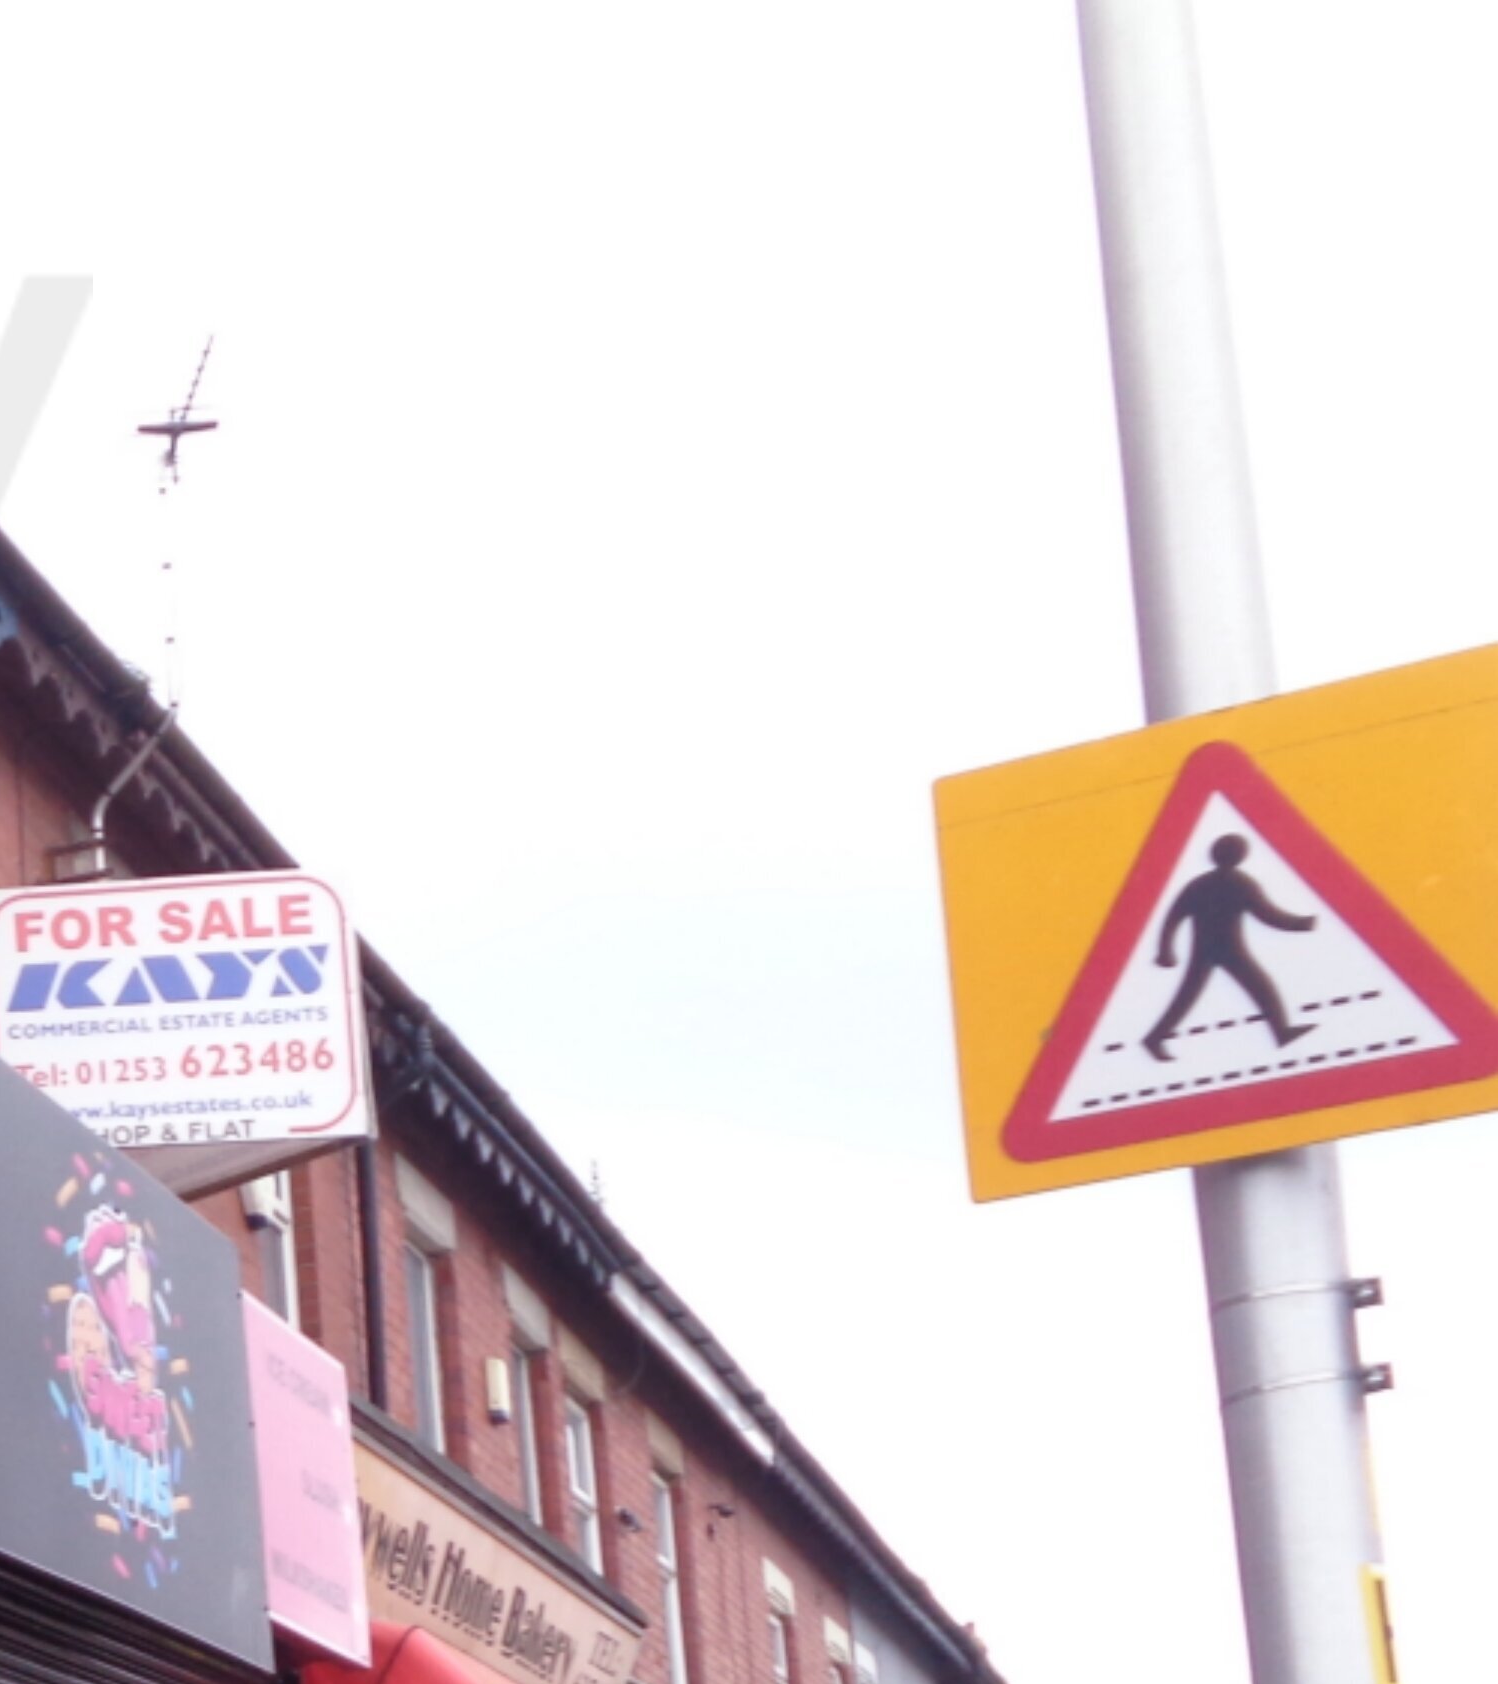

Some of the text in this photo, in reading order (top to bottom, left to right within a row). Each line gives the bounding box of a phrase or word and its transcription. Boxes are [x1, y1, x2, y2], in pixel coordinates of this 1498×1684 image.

[14, 894, 315, 954] FOR SALE
[6, 943, 329, 1013] KAYS
[7, 1006, 329, 1040] COMMERCIAL ESTATE AGENTS
[14, 1037, 335, 1087] Tel: 01253 623486
[95, 1124, 151, 1146] HOP
[188, 1119, 256, 1141] FLAT
[431, 1542, 504, 1647] Home
